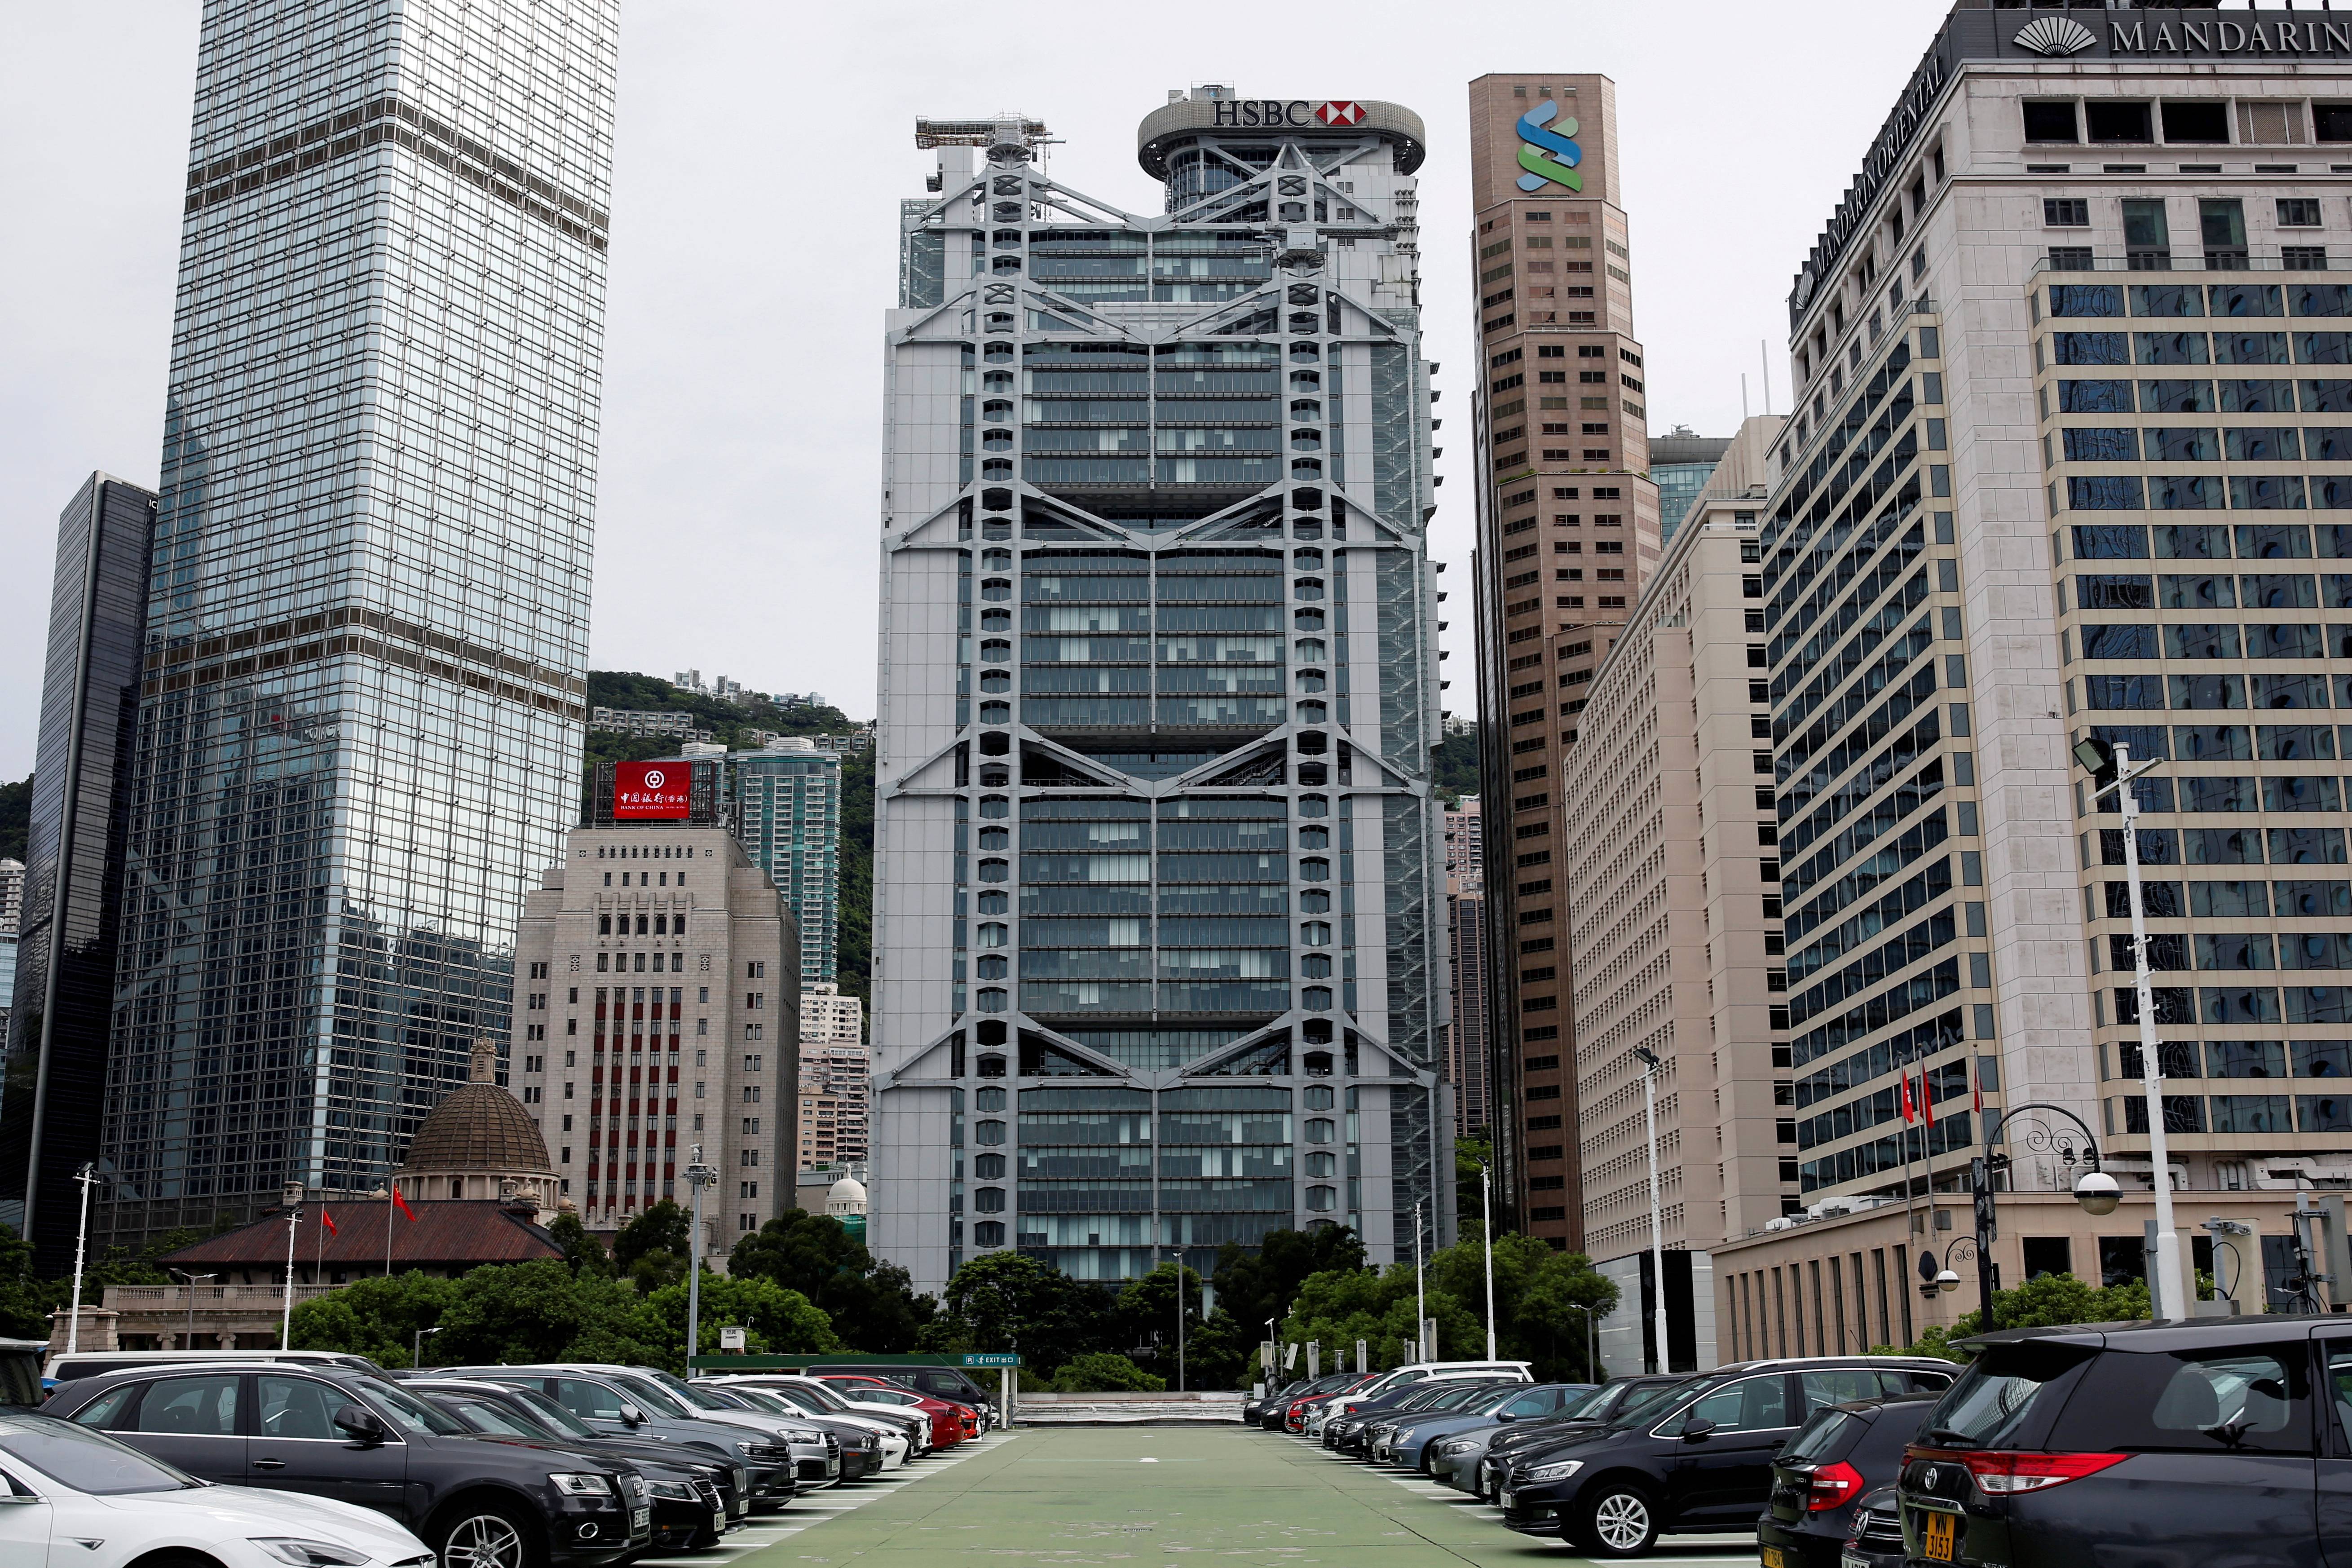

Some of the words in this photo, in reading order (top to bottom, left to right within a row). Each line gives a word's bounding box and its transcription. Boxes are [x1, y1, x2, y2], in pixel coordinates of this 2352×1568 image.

[2110, 22, 2351, 53] MANDARIN
[1212, 101, 1311, 127] HSBC
[1816, 161, 1877, 281] MANDARIN
[1877, 55, 1943, 178] ORIENTAL
[1935, 1513, 1947, 1536] WN
[1928, 1535, 1950, 1559] 3153
